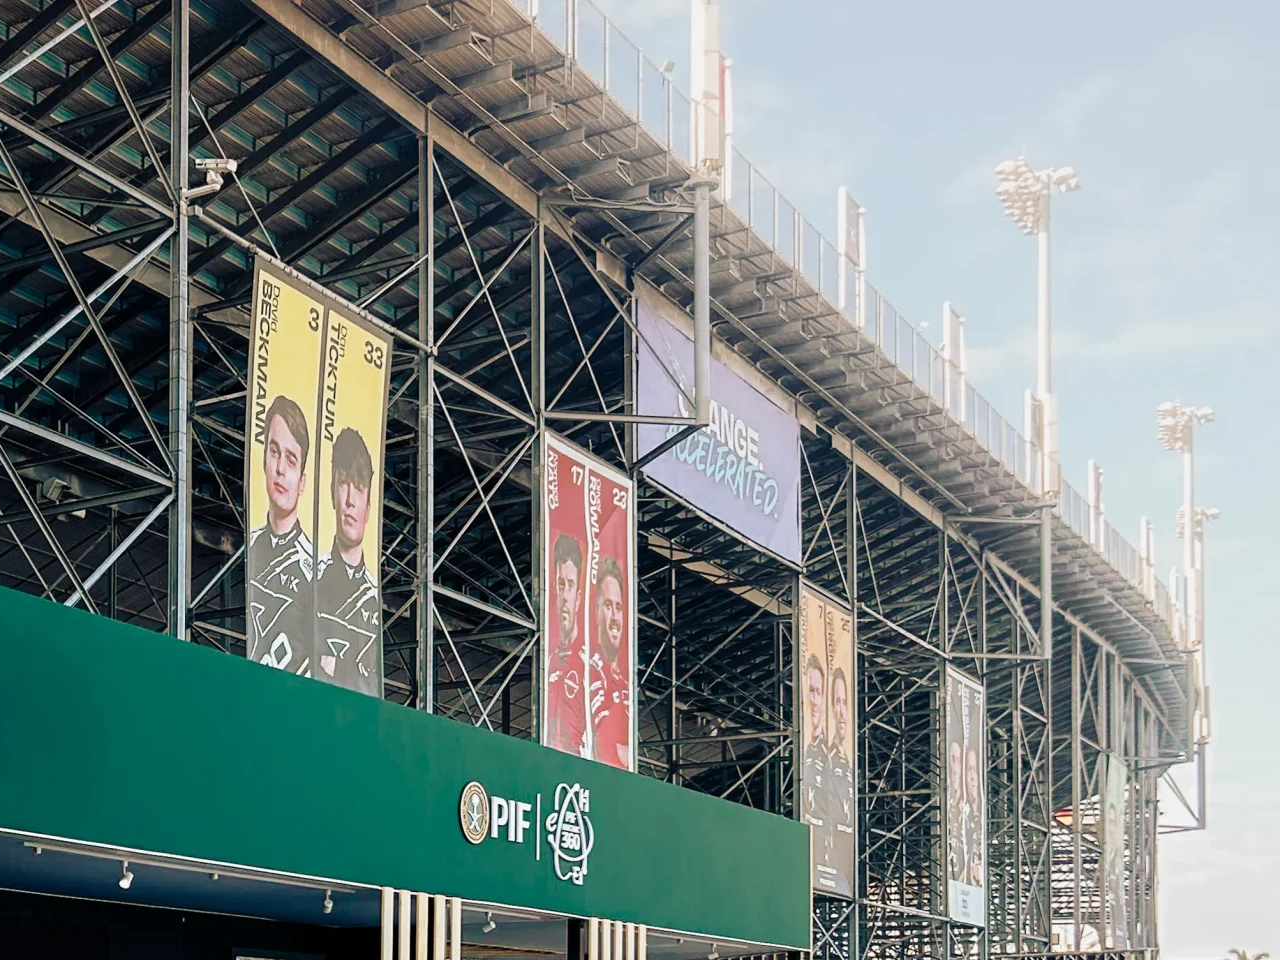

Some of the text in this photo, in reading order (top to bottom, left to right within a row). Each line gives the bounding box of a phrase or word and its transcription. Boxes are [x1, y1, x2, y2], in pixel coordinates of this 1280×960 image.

[270, 286, 280, 333] David
[308, 307, 319, 332] 3
[339, 325, 348, 358] Dan
[364, 341, 383, 370] 33
[255, 280, 272, 445] BECKMANN
[324, 322, 341, 443] TICKTUM
[571, 465, 584, 486] 17
[612, 488, 627, 510] 23
[589, 476, 600, 585] ROWLAND
[490, 795, 532, 843] PIF
